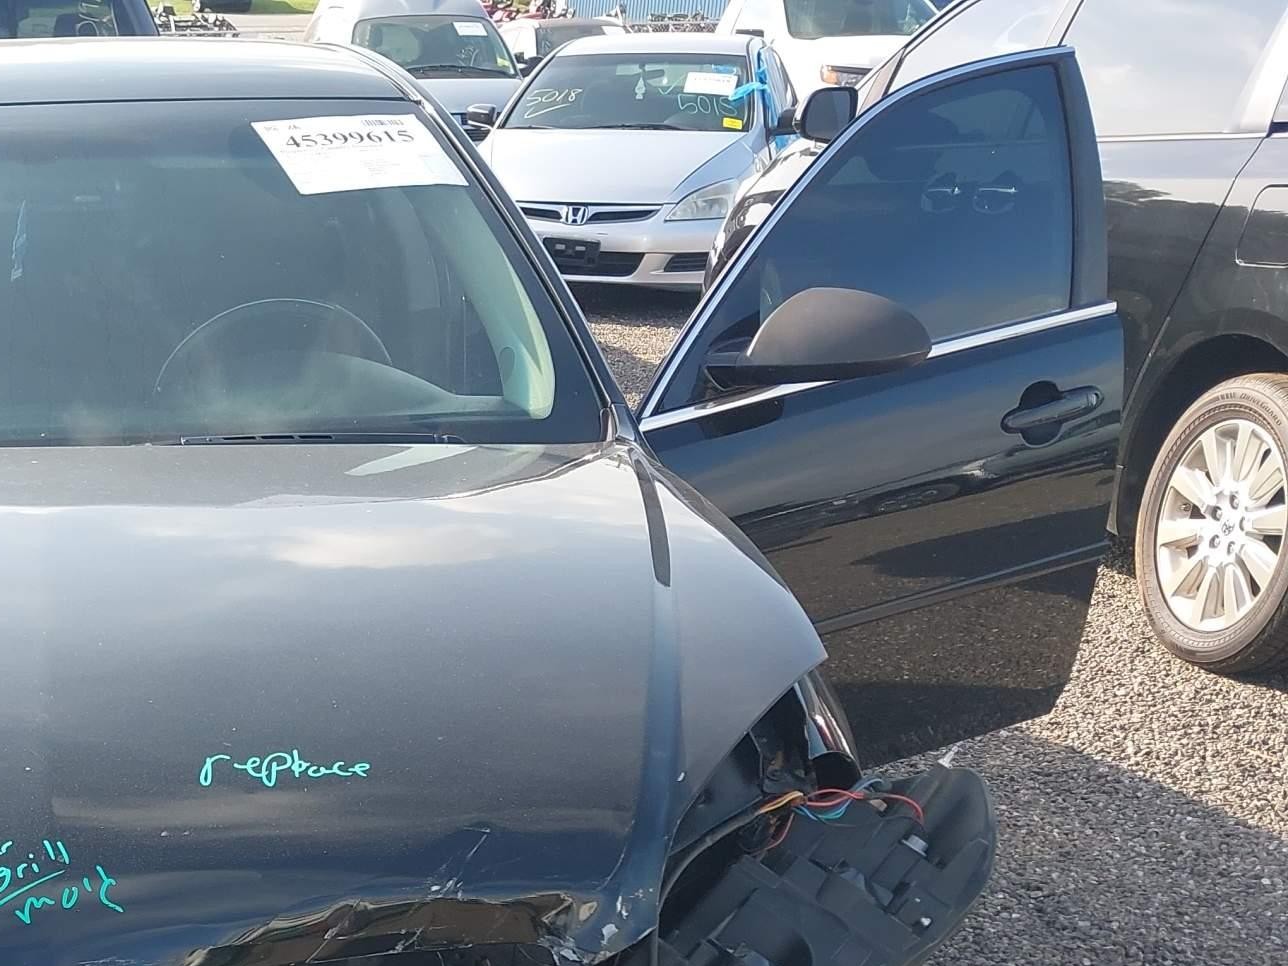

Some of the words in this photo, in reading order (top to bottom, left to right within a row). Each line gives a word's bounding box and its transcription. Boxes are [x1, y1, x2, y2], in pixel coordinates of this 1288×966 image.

[526, 88, 583, 106] 5018
[285, 130, 415, 148] 45399615
[199, 749, 371, 787] replace
